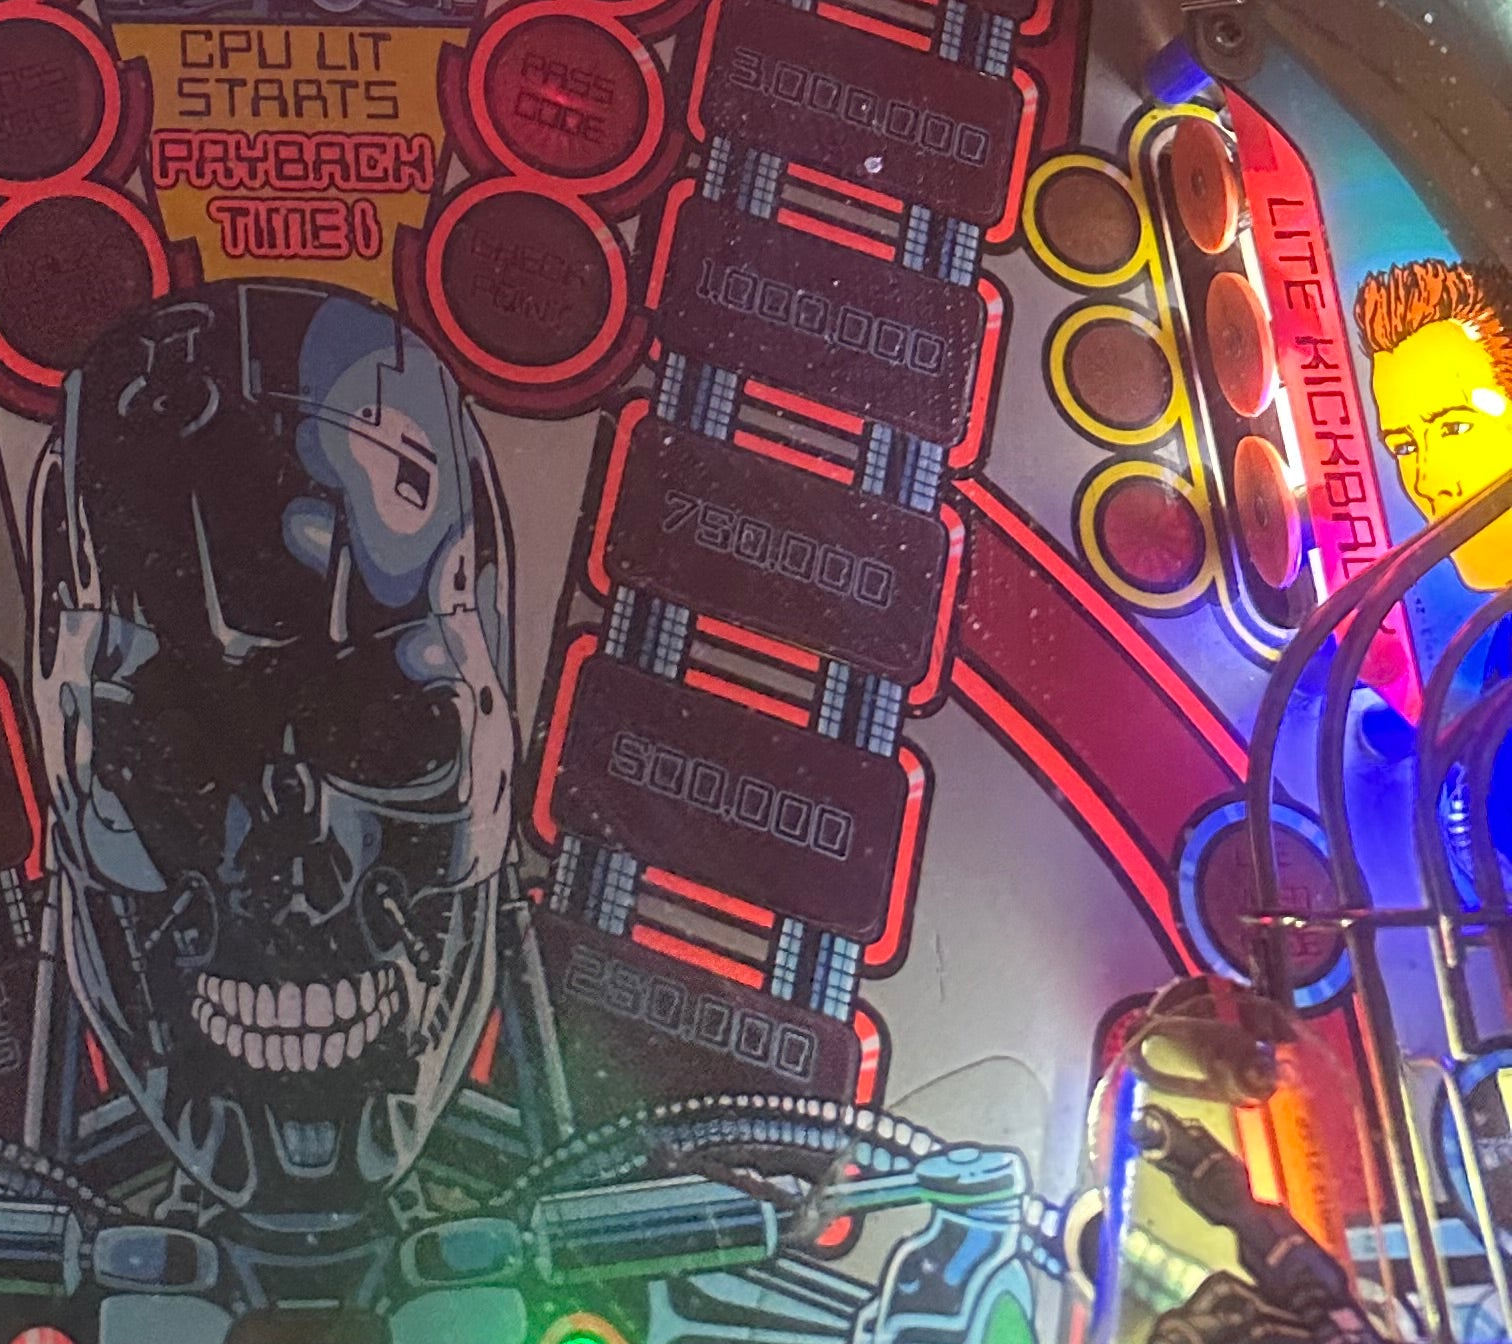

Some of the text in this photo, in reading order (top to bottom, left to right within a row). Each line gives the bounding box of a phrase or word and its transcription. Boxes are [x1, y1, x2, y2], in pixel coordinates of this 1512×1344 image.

[179, 30, 392, 72] CPU LIT
[520, 51, 616, 102] PASS
[177, 77, 399, 120] STARTS
[513, 94, 609, 145] CODE
[152, 129, 435, 193] PAYBACK
[1267, 196, 1328, 314] LITE
